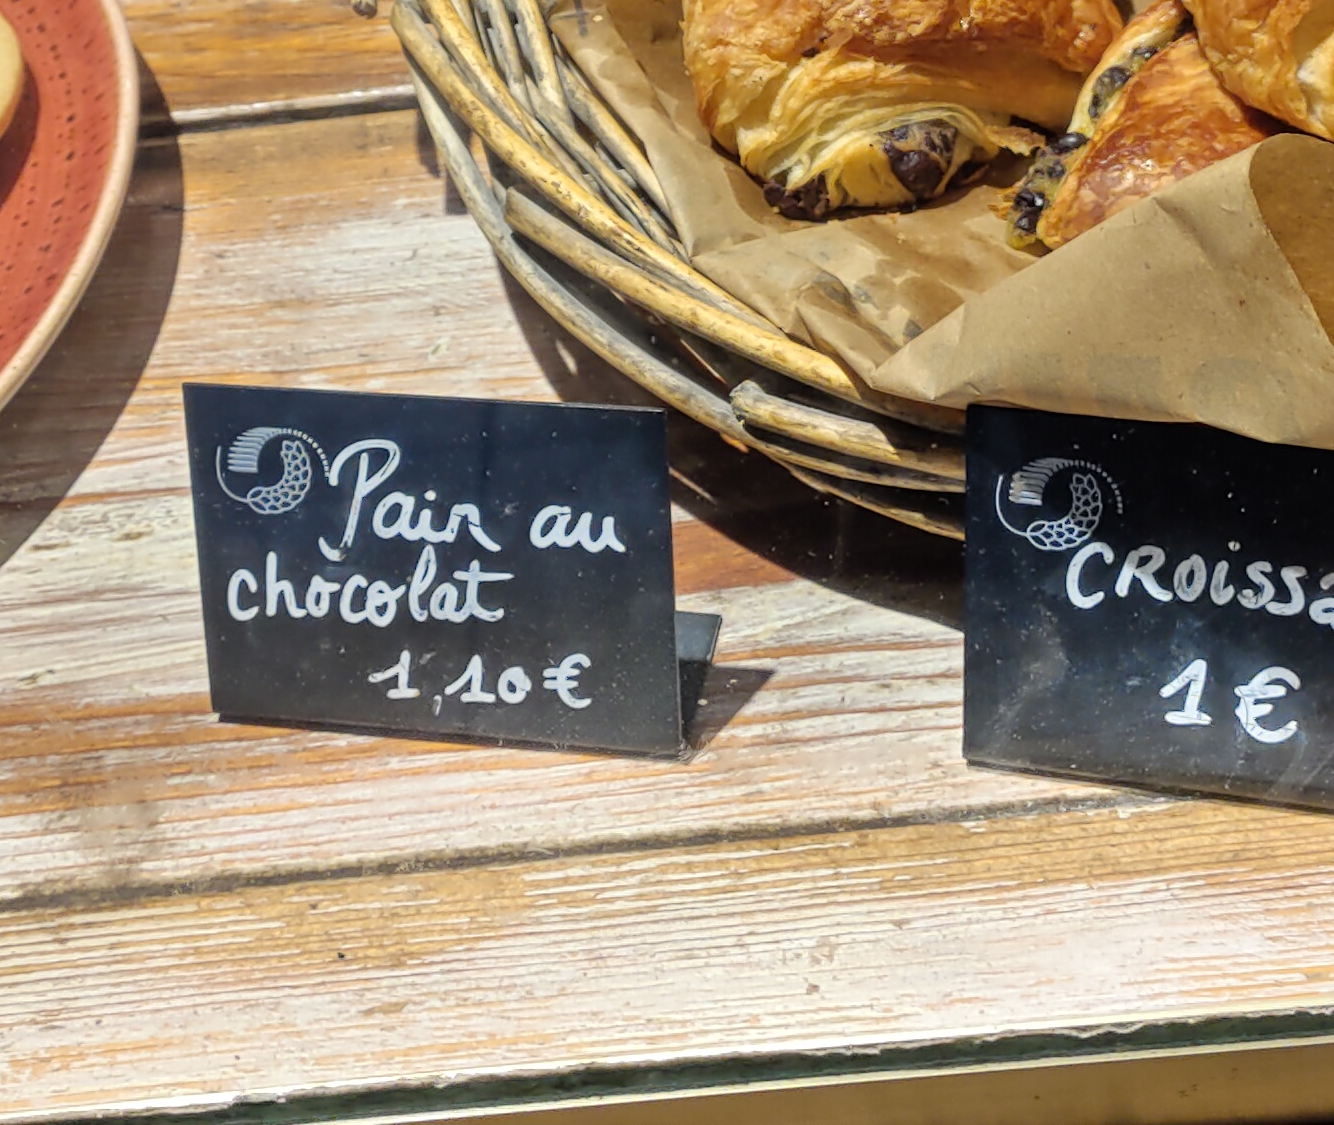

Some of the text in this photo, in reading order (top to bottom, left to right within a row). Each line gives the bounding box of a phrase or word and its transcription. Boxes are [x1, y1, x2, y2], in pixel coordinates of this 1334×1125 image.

[317, 438, 627, 563] Pain au
[226, 544, 516, 629] chocolat
[367, 649, 593, 716] 1,10€
